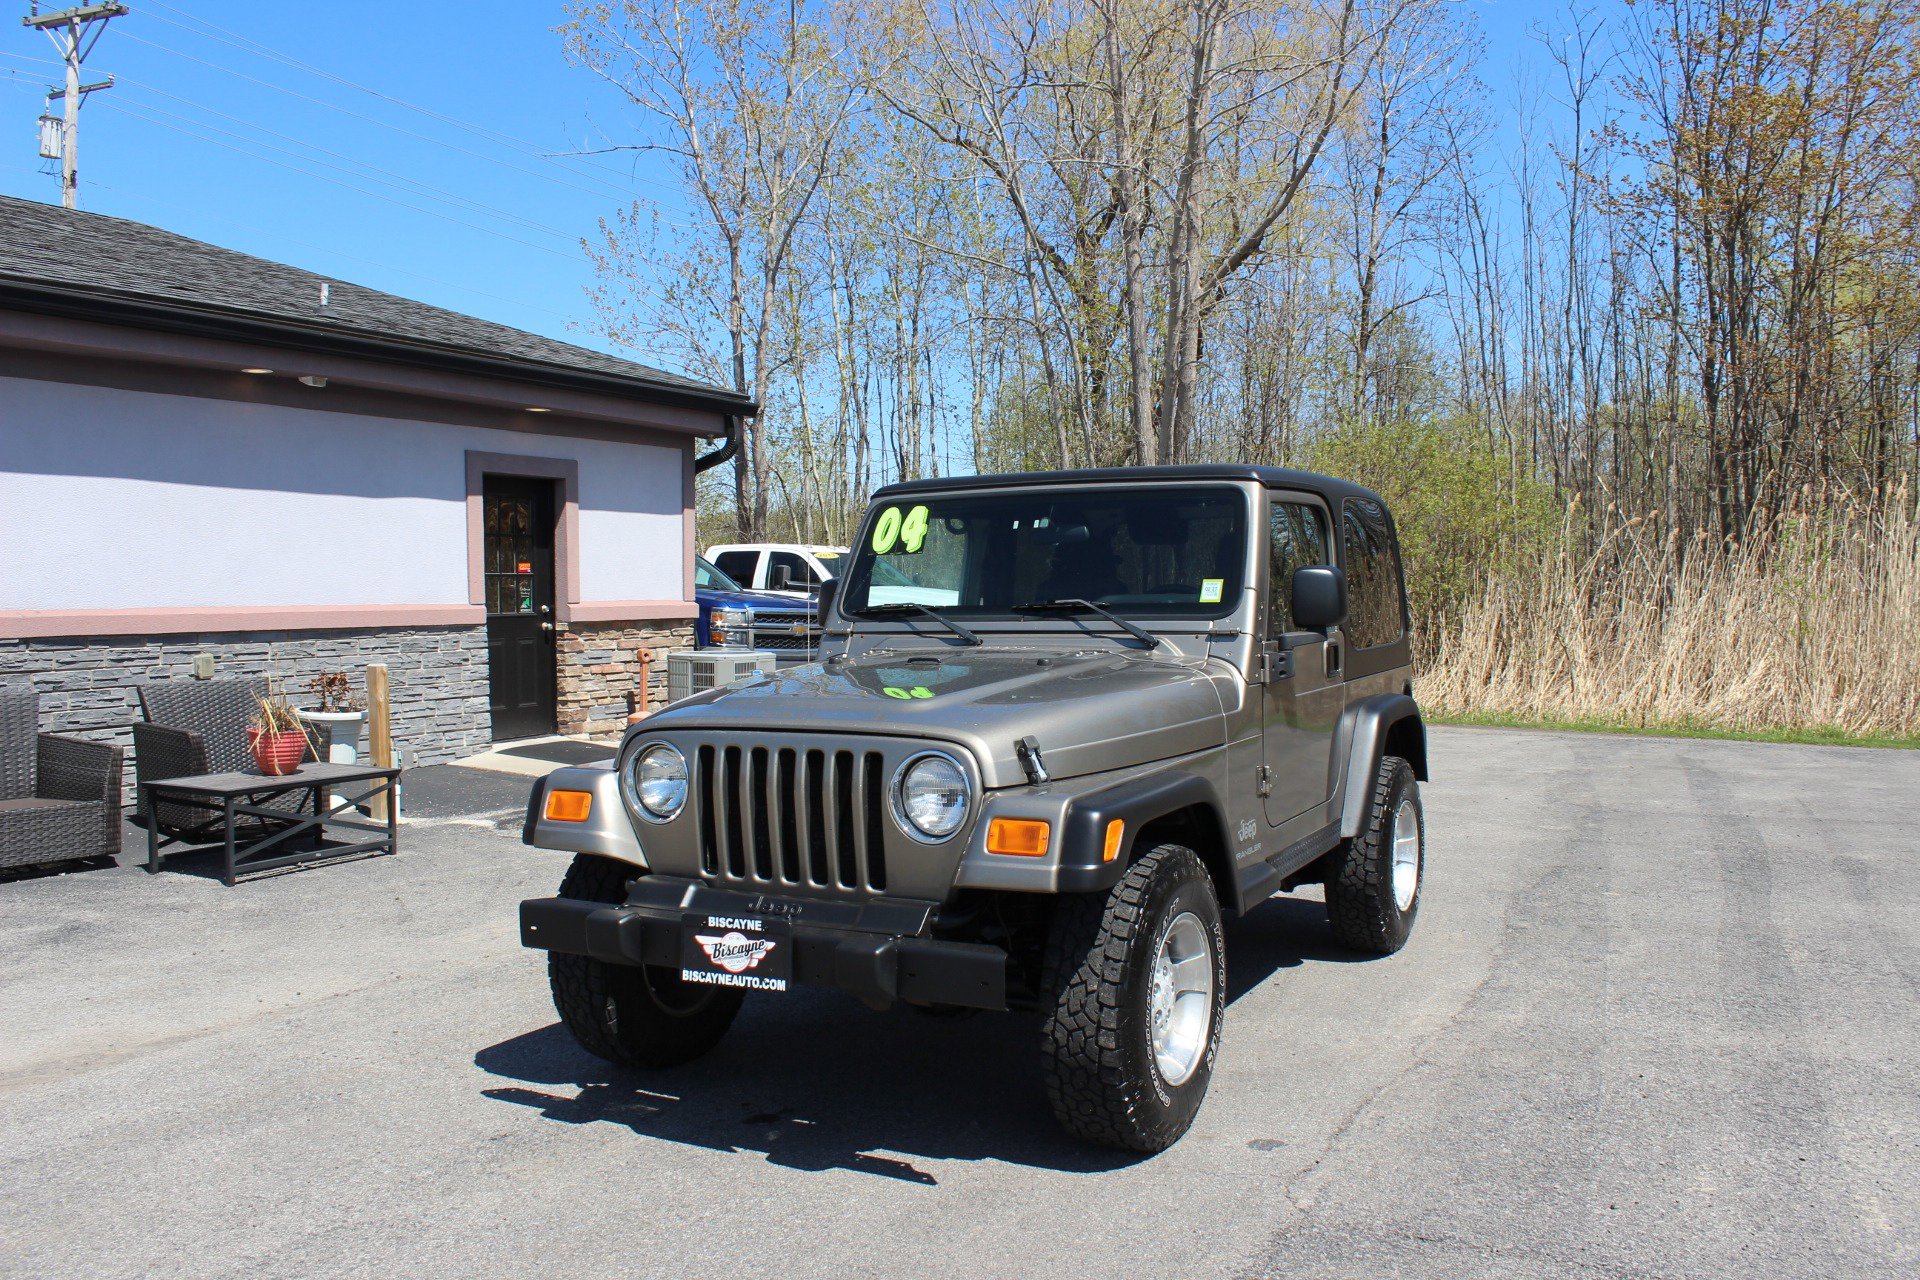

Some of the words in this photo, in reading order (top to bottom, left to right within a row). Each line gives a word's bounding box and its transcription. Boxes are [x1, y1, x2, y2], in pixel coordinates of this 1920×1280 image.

[872, 505, 929, 554] 04
[708, 917, 762, 931] BISCAYNE
[711, 940, 766, 959] Biscayne
[1213, 922, 1226, 987] TOYO
[682, 969, 786, 991] BISCAYNEAUTO.COM
